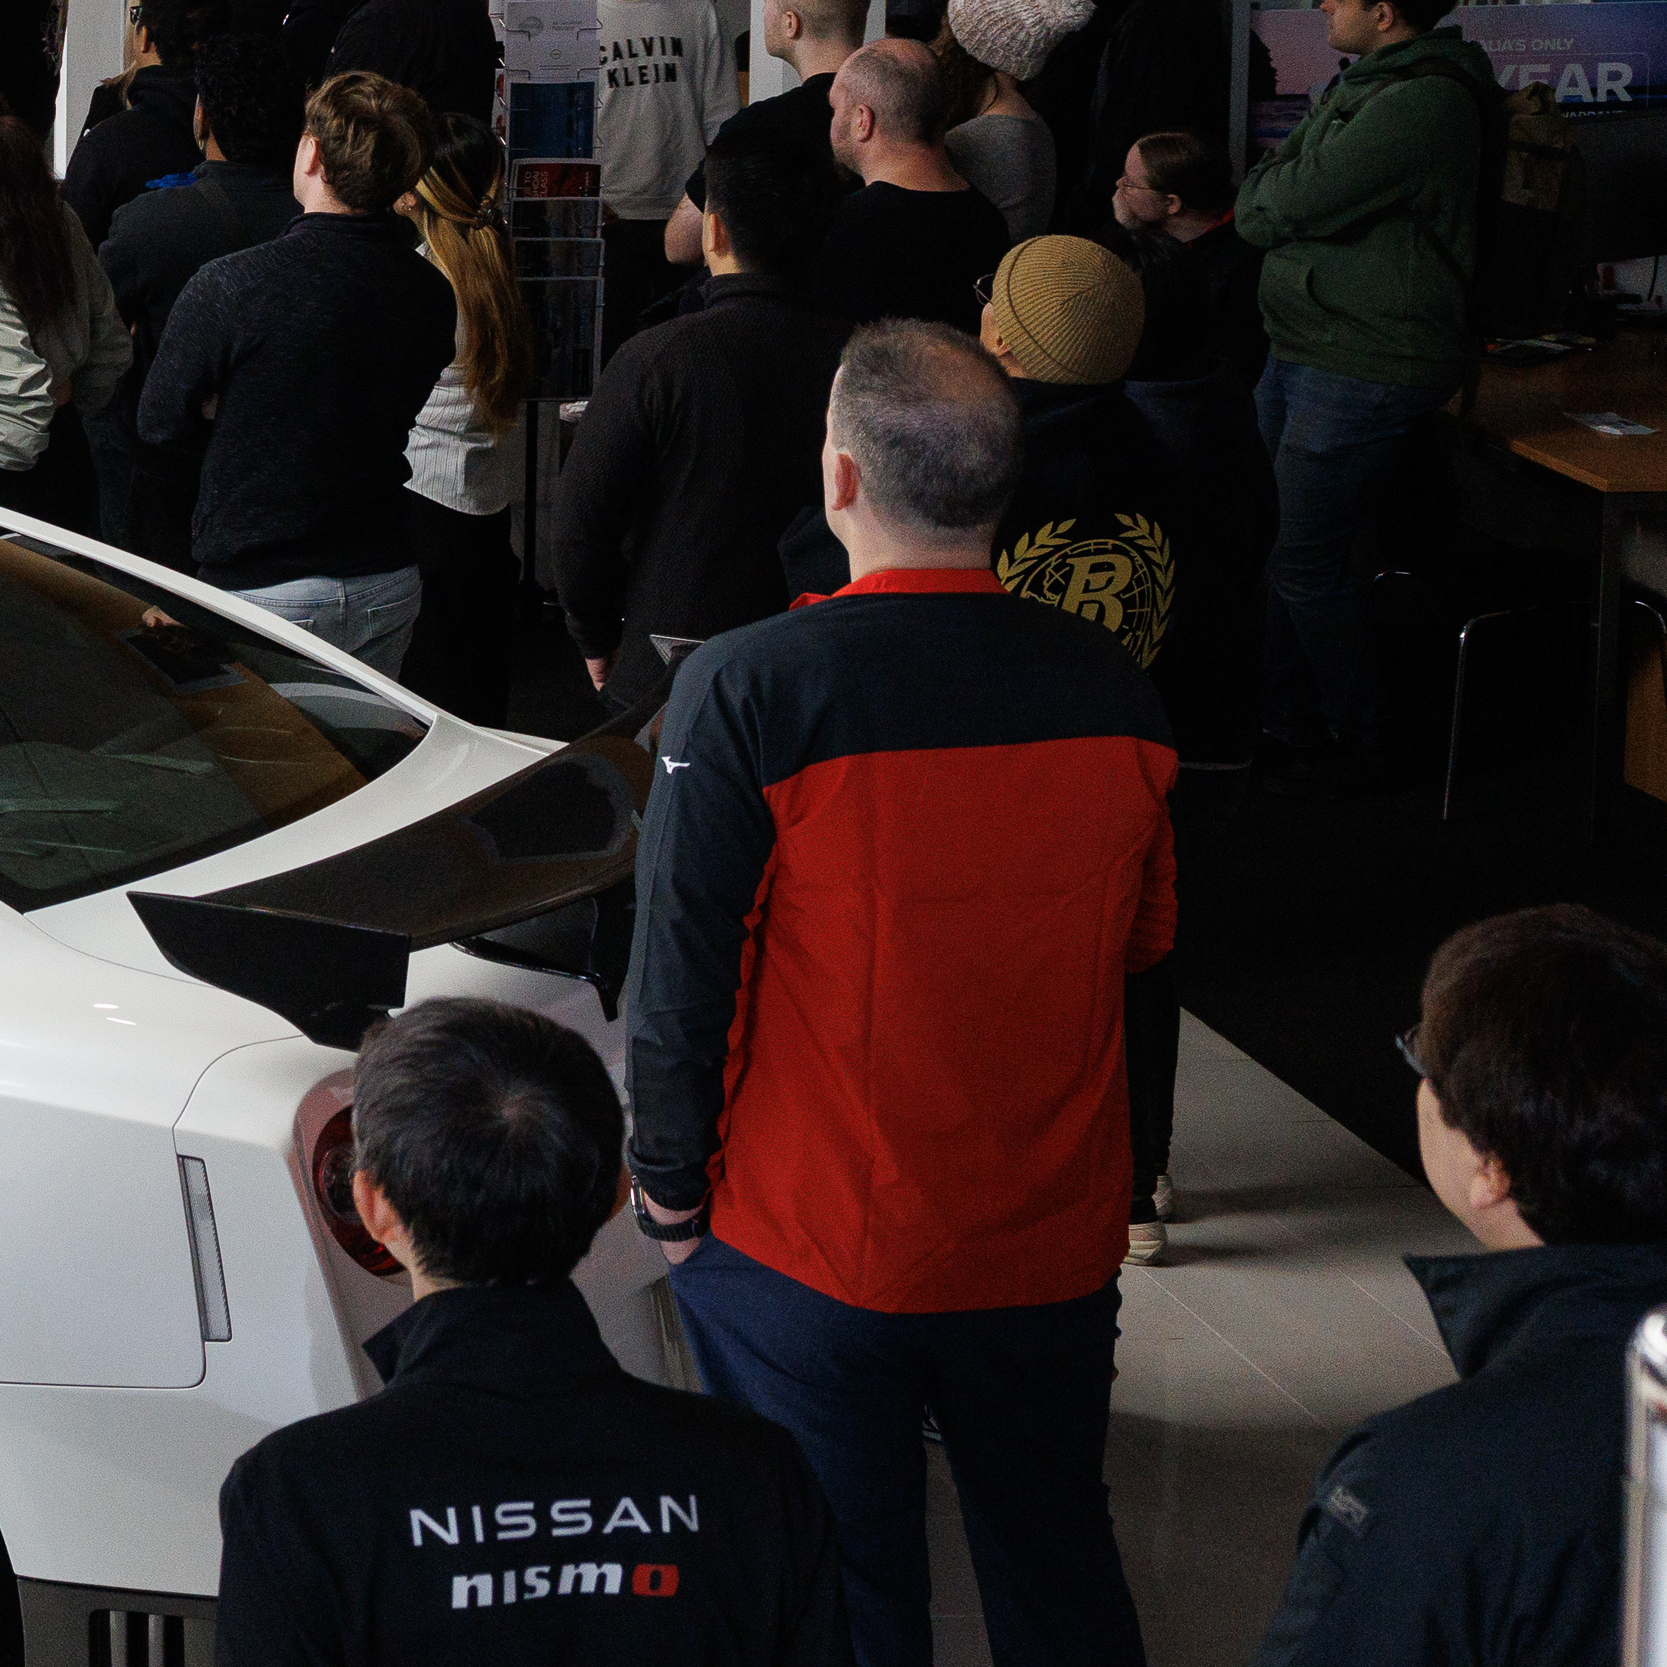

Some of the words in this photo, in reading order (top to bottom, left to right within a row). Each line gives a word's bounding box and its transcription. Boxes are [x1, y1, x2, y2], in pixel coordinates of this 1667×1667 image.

[1531, 37, 1575, 52] ONLY
[607, 63, 677, 89] KLEIN
[409, 1494, 700, 1547] NISSAN
[451, 1562, 681, 1609] nismo
